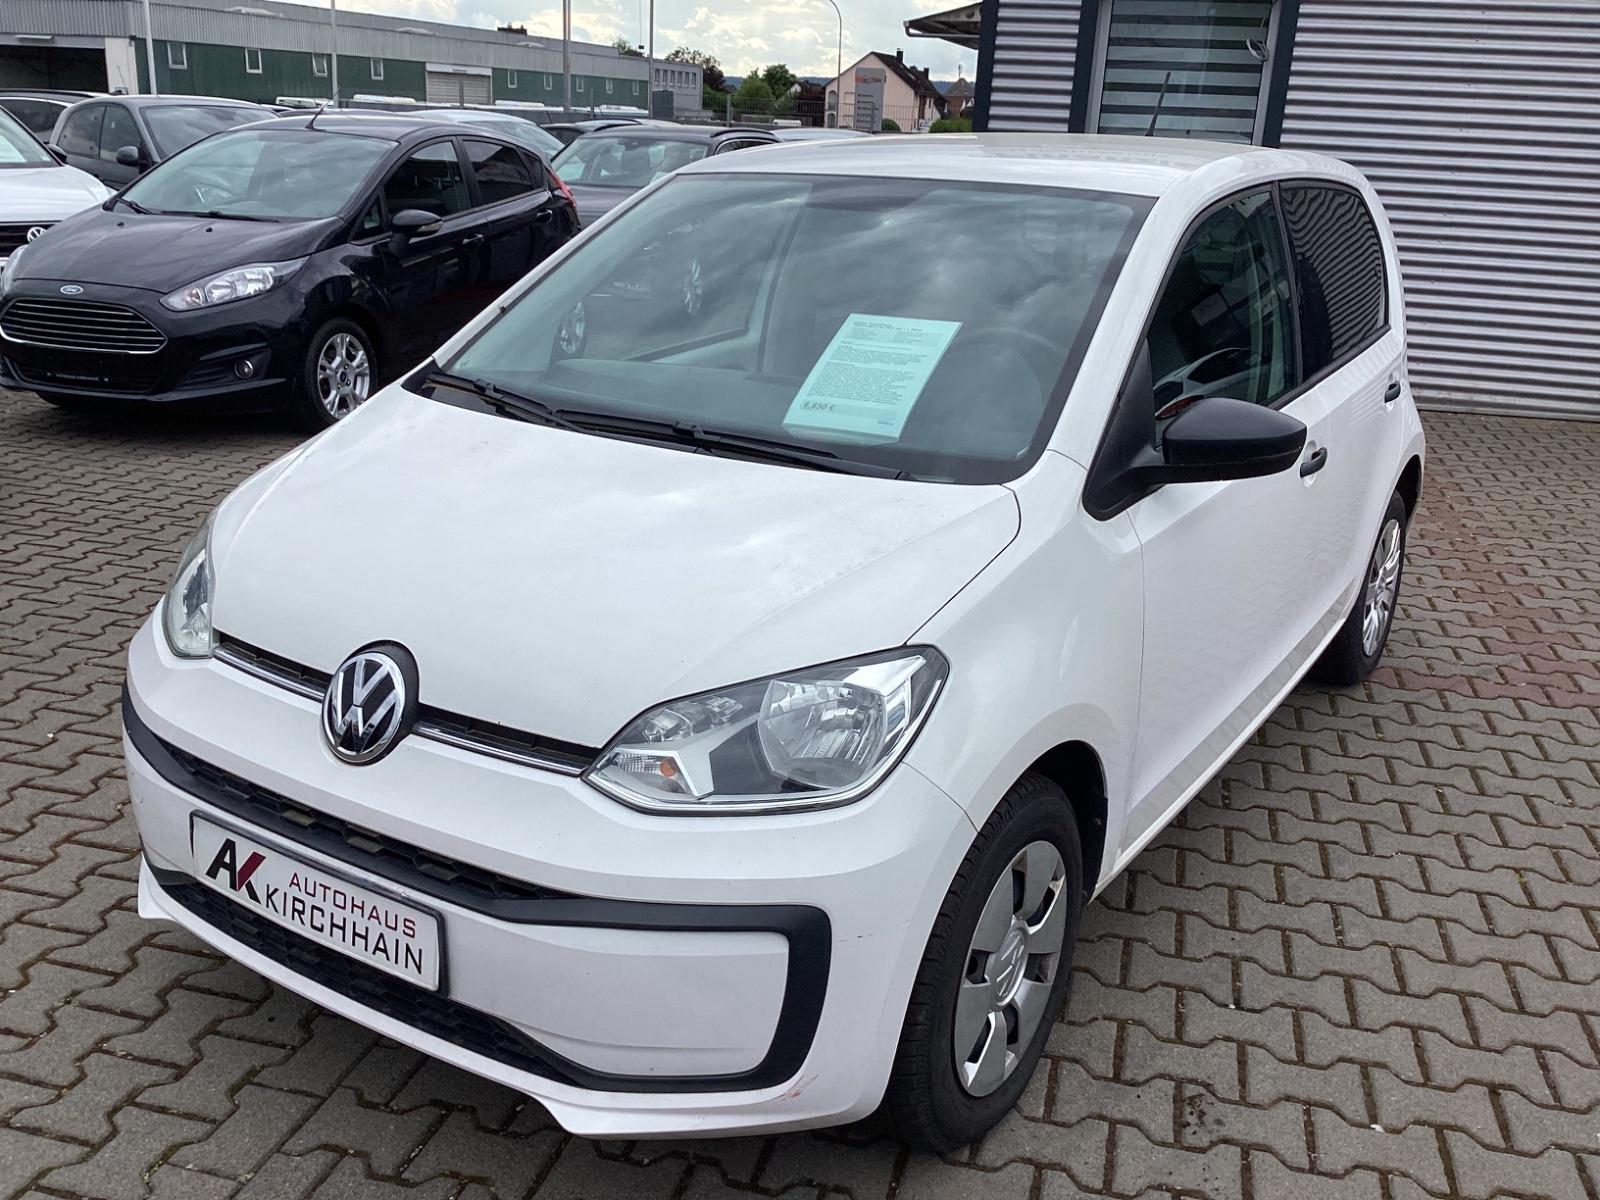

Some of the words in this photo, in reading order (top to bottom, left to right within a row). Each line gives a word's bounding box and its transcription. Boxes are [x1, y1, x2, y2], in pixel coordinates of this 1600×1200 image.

[205, 837, 266, 905] AK
[265, 883, 423, 975] KIRCHHAIN
[289, 872, 417, 939] AUTOHAUS
